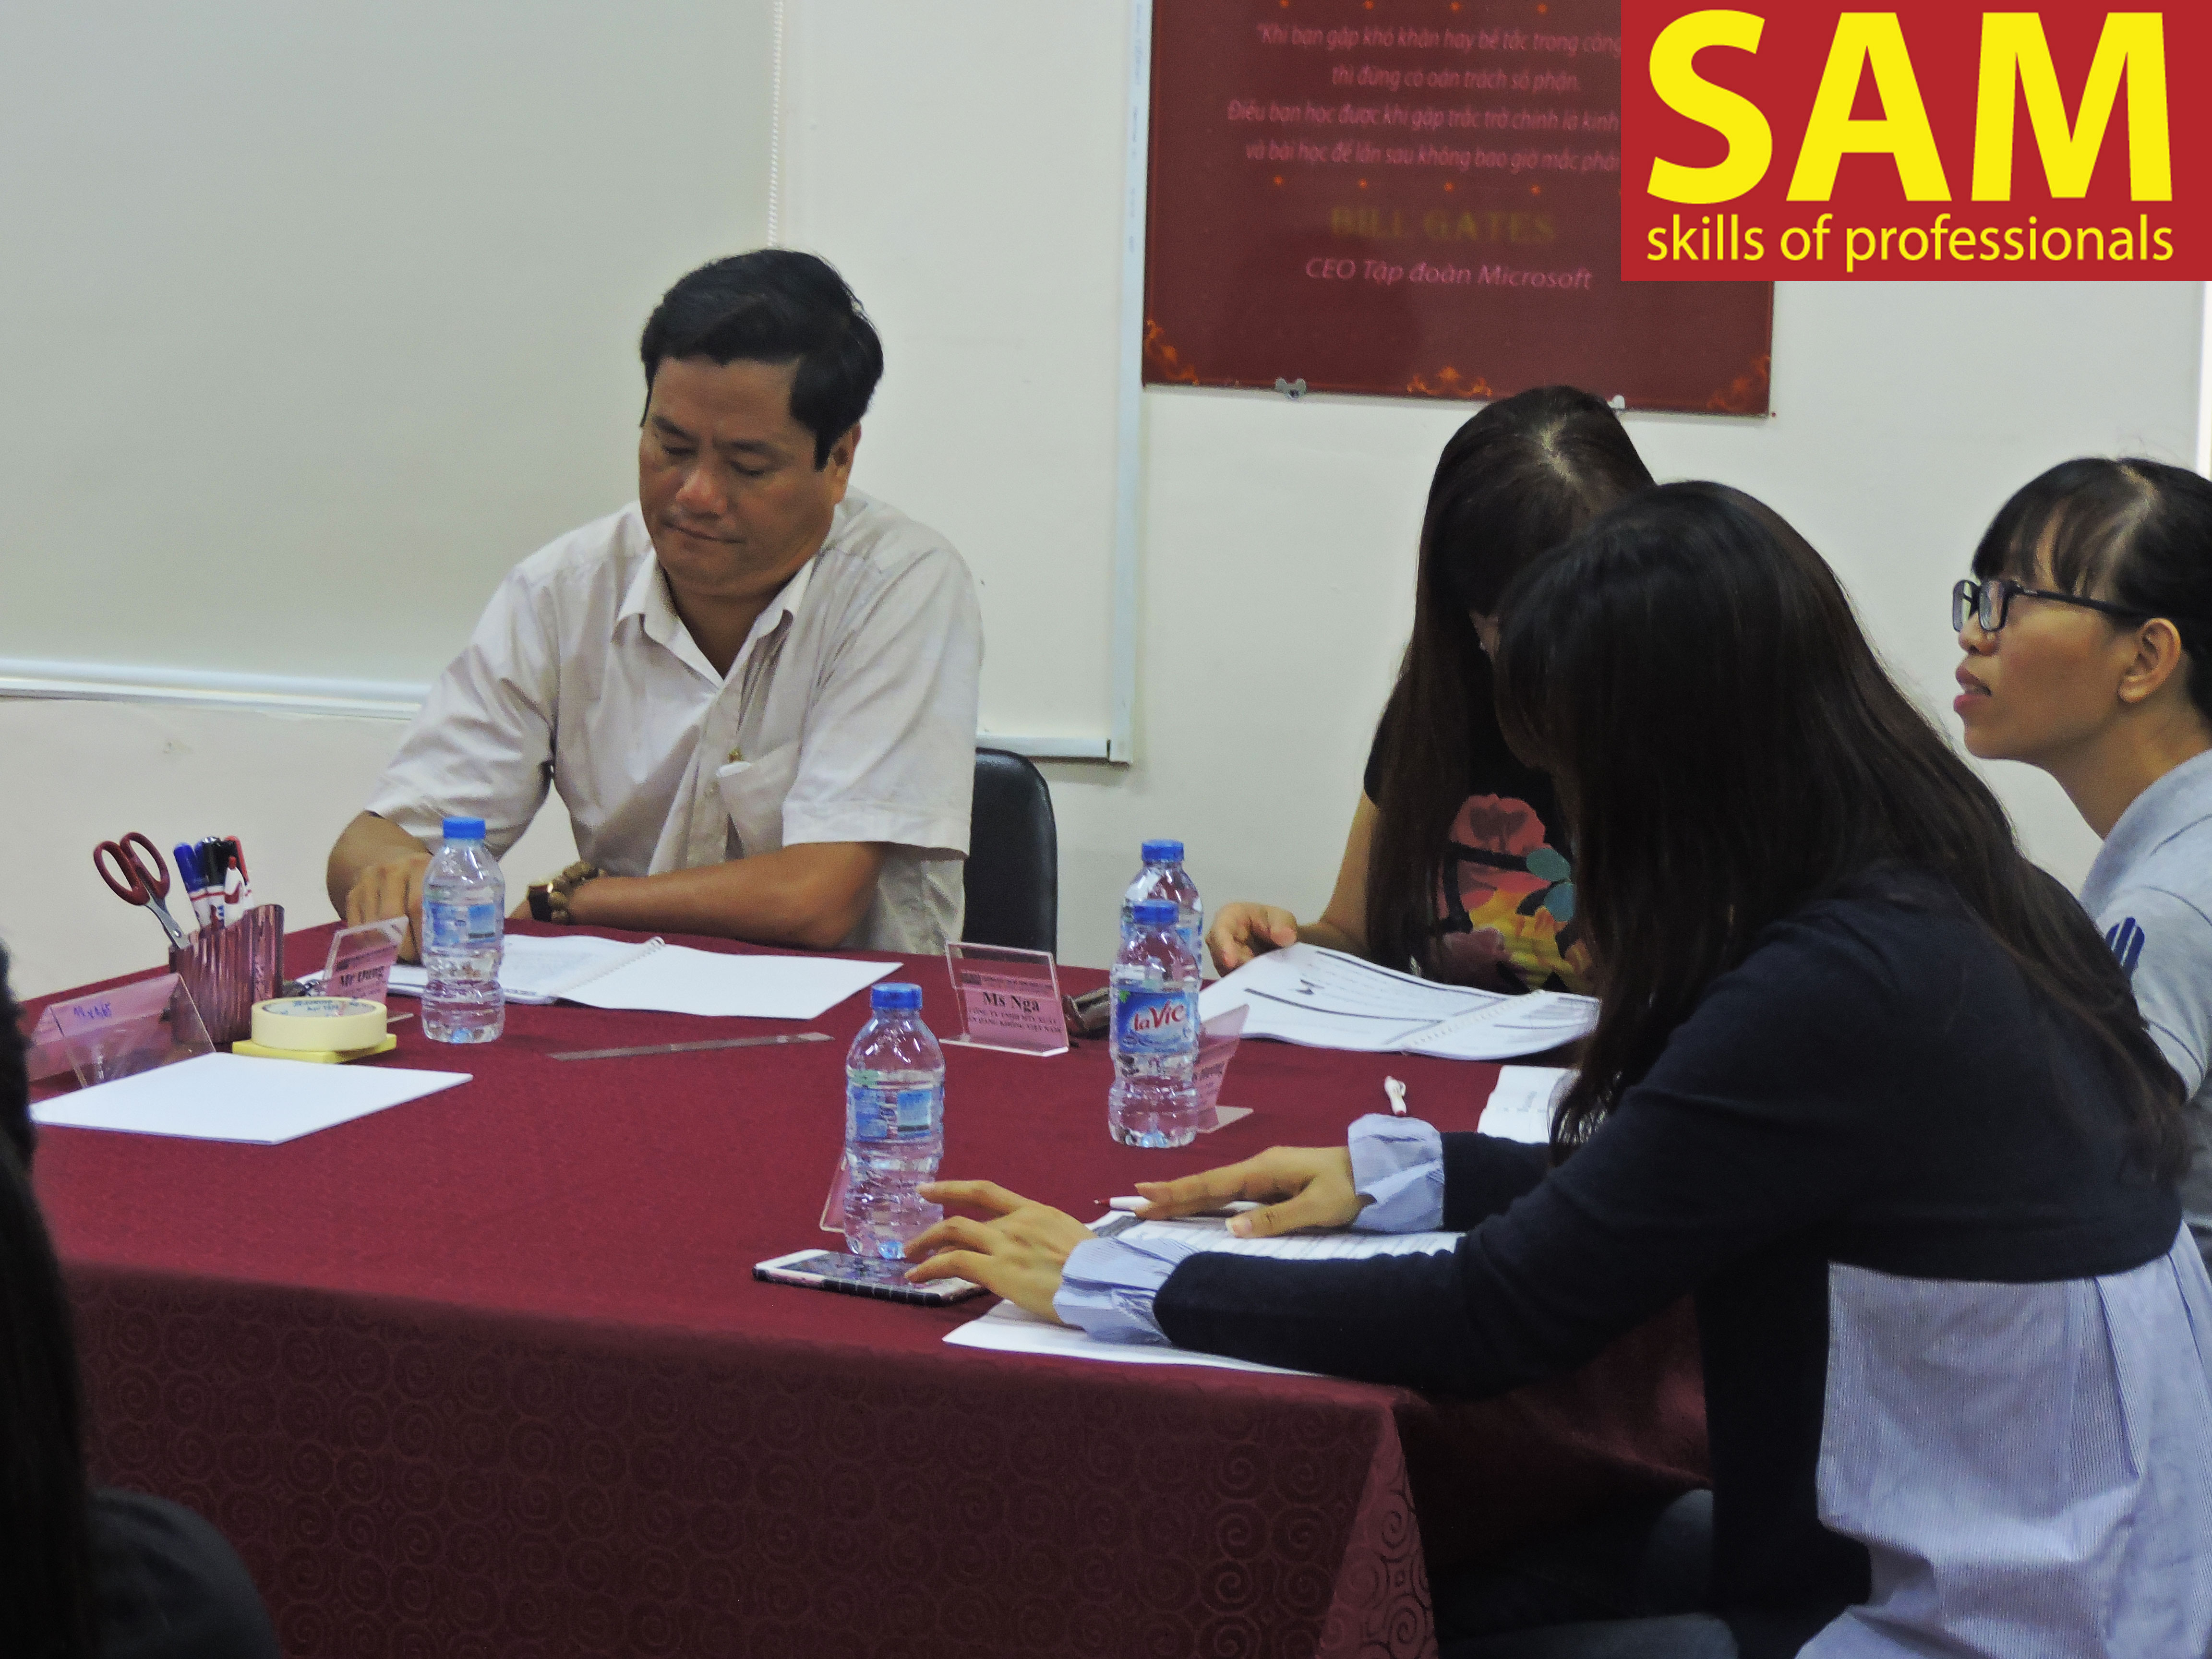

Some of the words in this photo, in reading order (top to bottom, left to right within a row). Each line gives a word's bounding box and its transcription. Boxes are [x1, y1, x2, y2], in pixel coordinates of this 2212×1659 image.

[1331, 207, 1402, 240] BILL
[1424, 210, 1555, 244] GATES
[1305, 258, 1356, 280] CEO
[1478, 265, 1593, 289] Microsoft
[983, 992, 1006, 1007] Ms
[1011, 996, 1039, 1014] Nga
